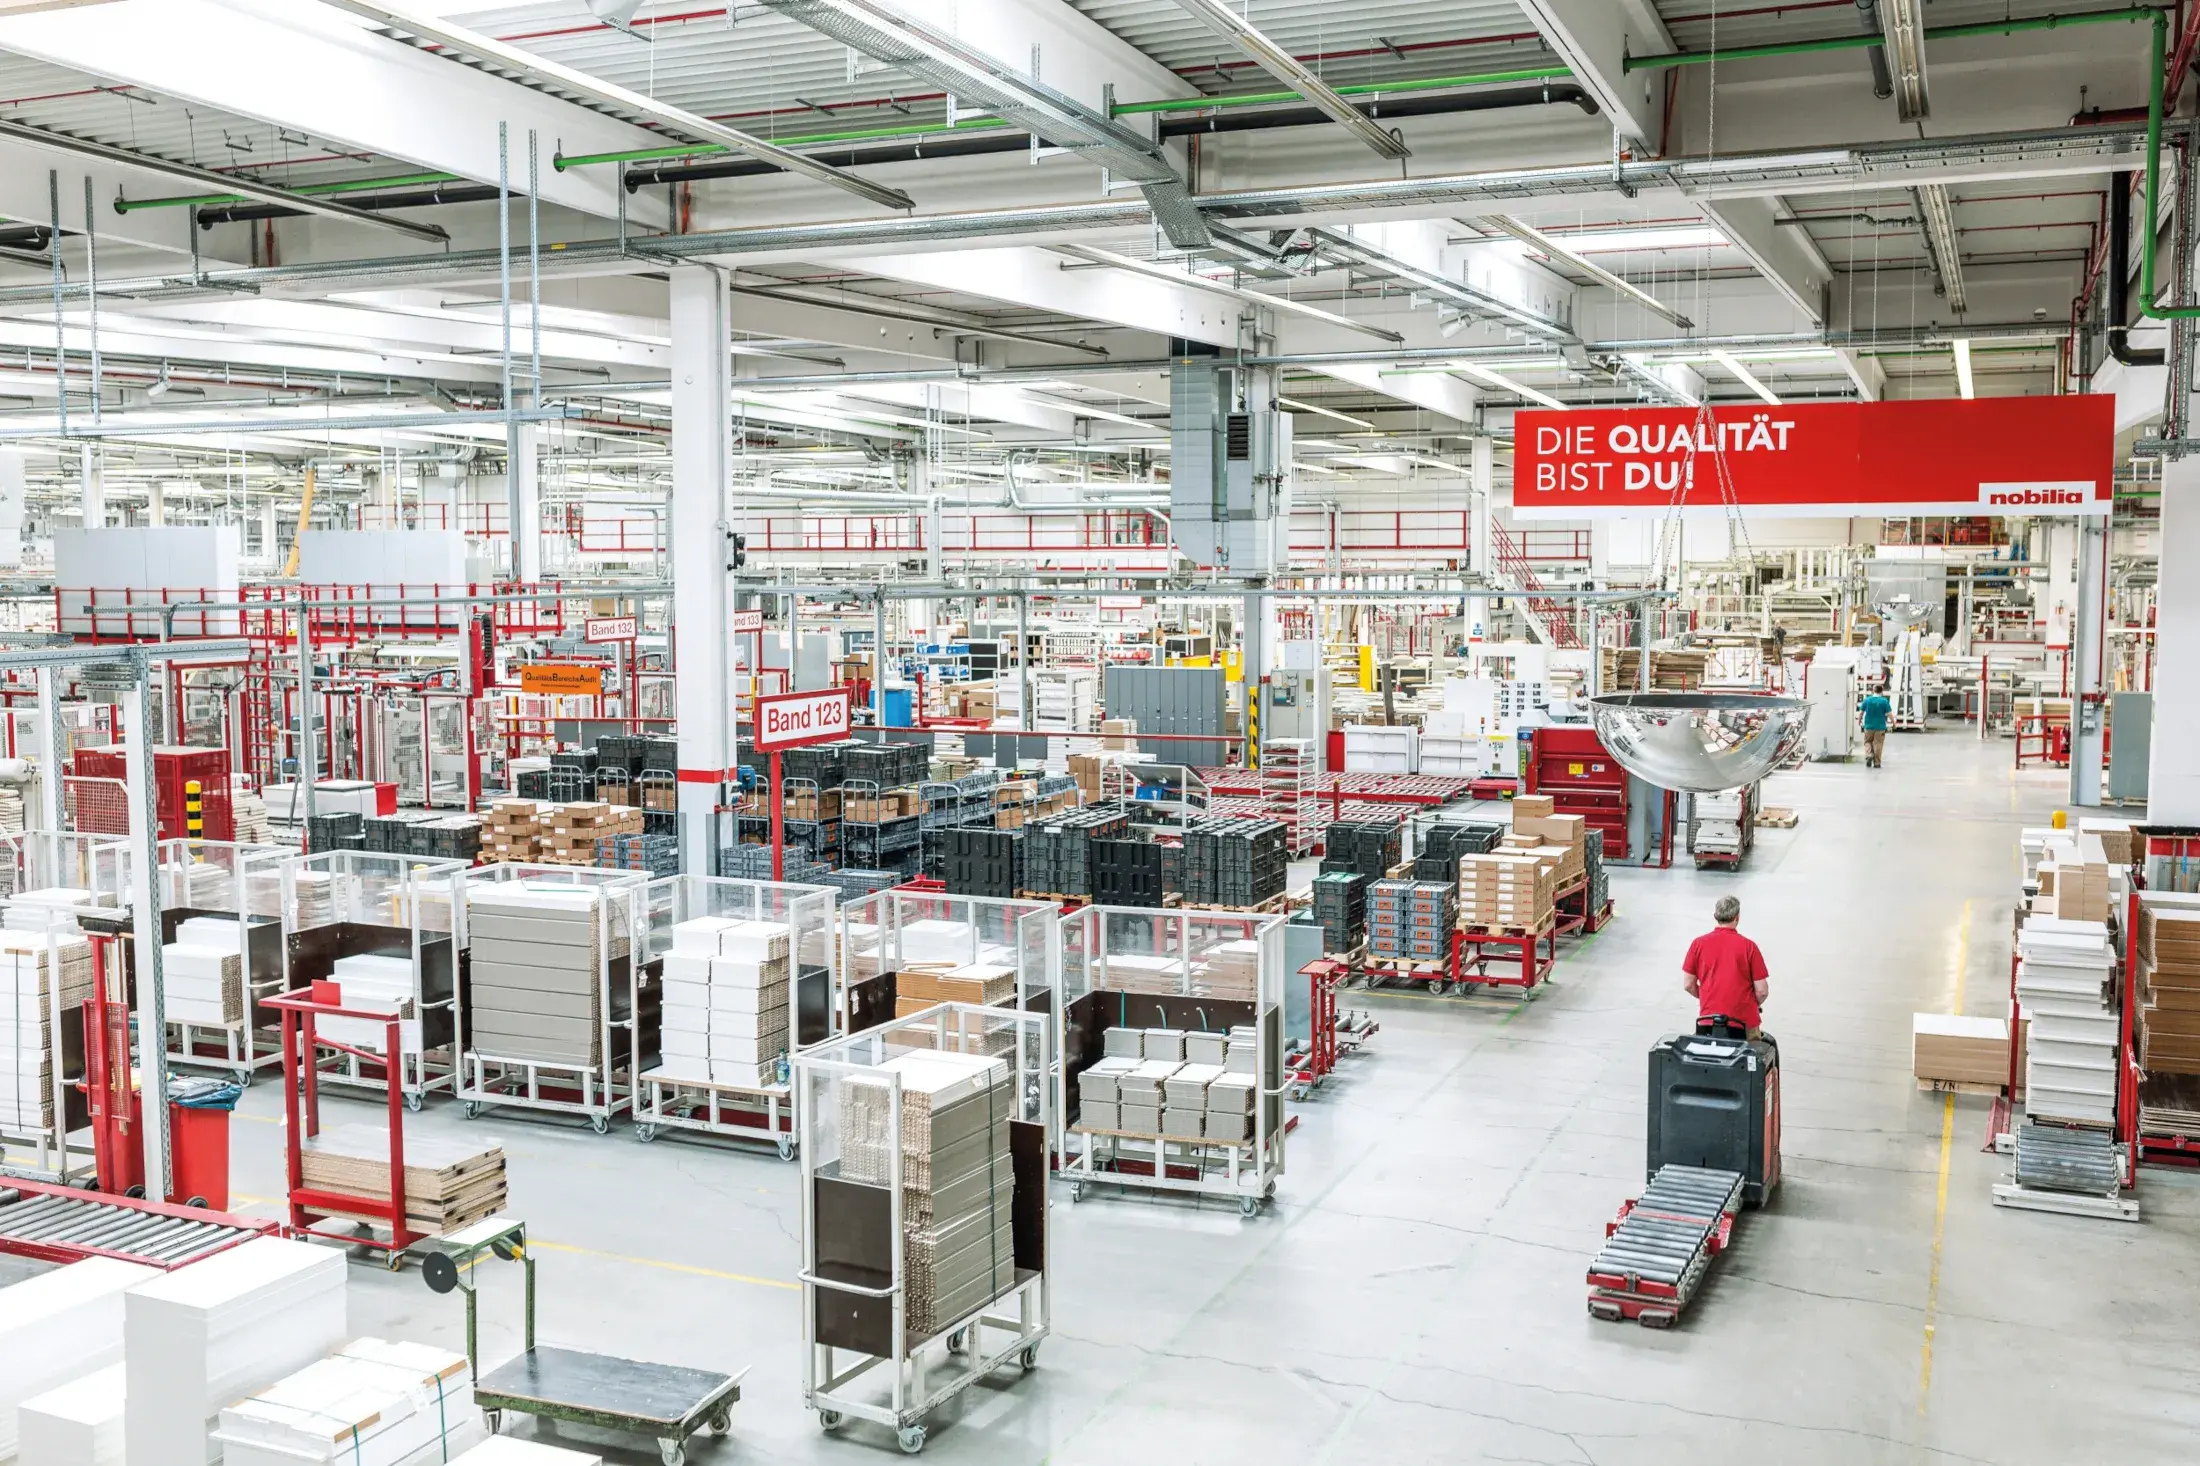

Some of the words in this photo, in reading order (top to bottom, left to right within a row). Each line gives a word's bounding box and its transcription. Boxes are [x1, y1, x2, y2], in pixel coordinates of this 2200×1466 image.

[1537, 426, 1595, 455] DIE
[1607, 414, 1796, 454] QUALITÄT
[1537, 462, 1613, 491] BIST
[1624, 461, 1694, 491] DU!
[1990, 489, 2083, 505] nobilia
[591, 623, 615, 636] Band
[617, 621, 633, 634] 132
[747, 614, 760, 626] 133
[768, 704, 811, 733] Band
[815, 701, 842, 727] 123
